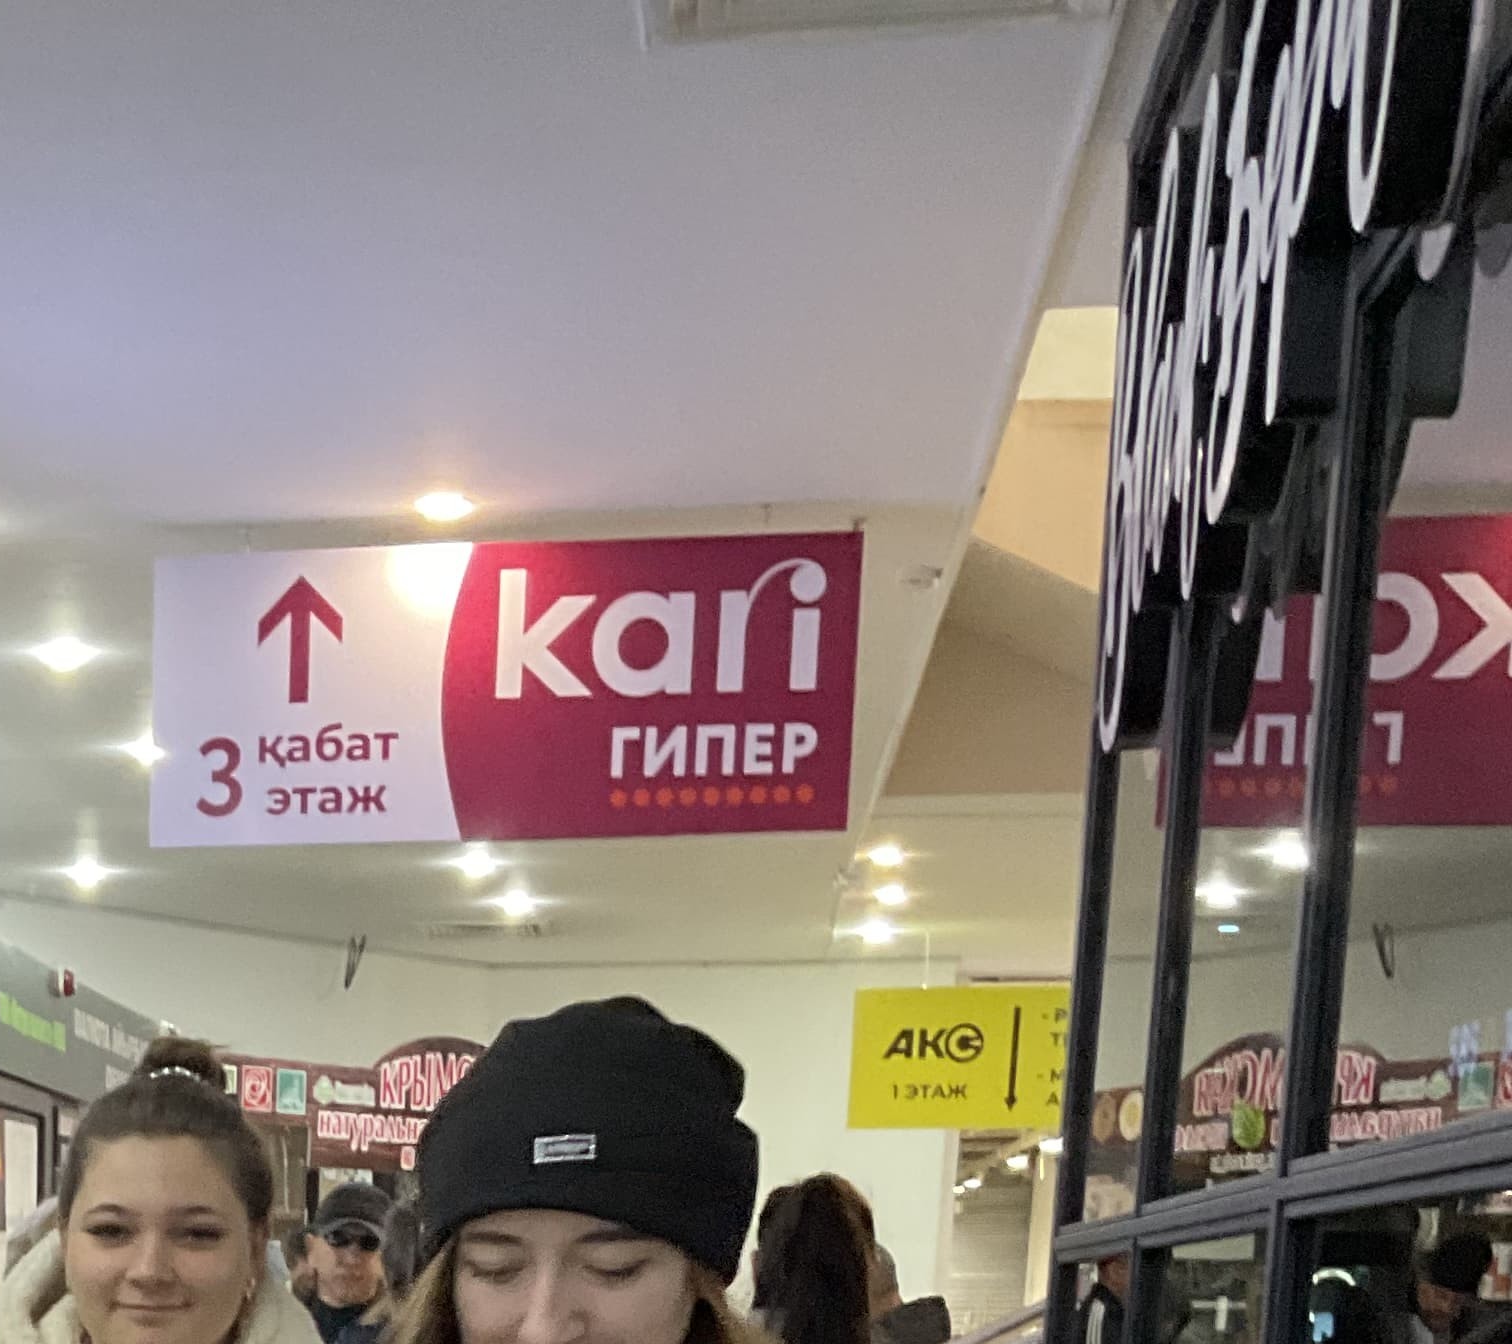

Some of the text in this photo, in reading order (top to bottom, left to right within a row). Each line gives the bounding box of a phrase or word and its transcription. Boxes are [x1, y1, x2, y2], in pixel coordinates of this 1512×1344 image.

[494, 558, 827, 699] kari
[196, 722, 399, 817] 3 қабат
[611, 723, 818, 777] ГИПЕР
[265, 782, 388, 815] этаж
[893, 1083, 968, 1101] 1 ЭТАЖ
